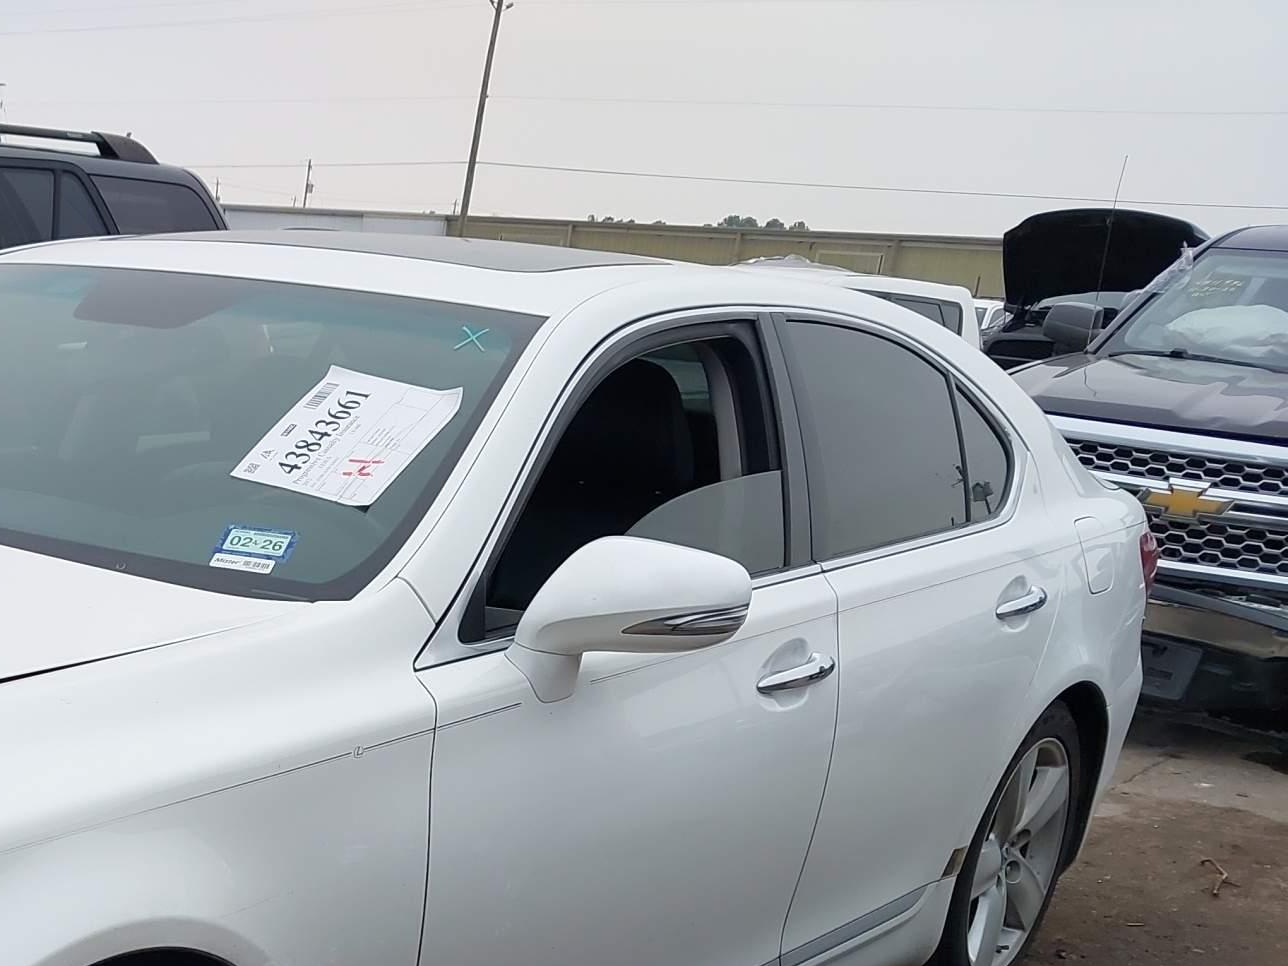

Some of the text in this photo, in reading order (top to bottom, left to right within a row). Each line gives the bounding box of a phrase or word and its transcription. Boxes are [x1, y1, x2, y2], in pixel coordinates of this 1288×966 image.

[277, 388, 372, 476] 43843661
[229, 535, 253, 548] 02
[260, 539, 285, 552] 26
